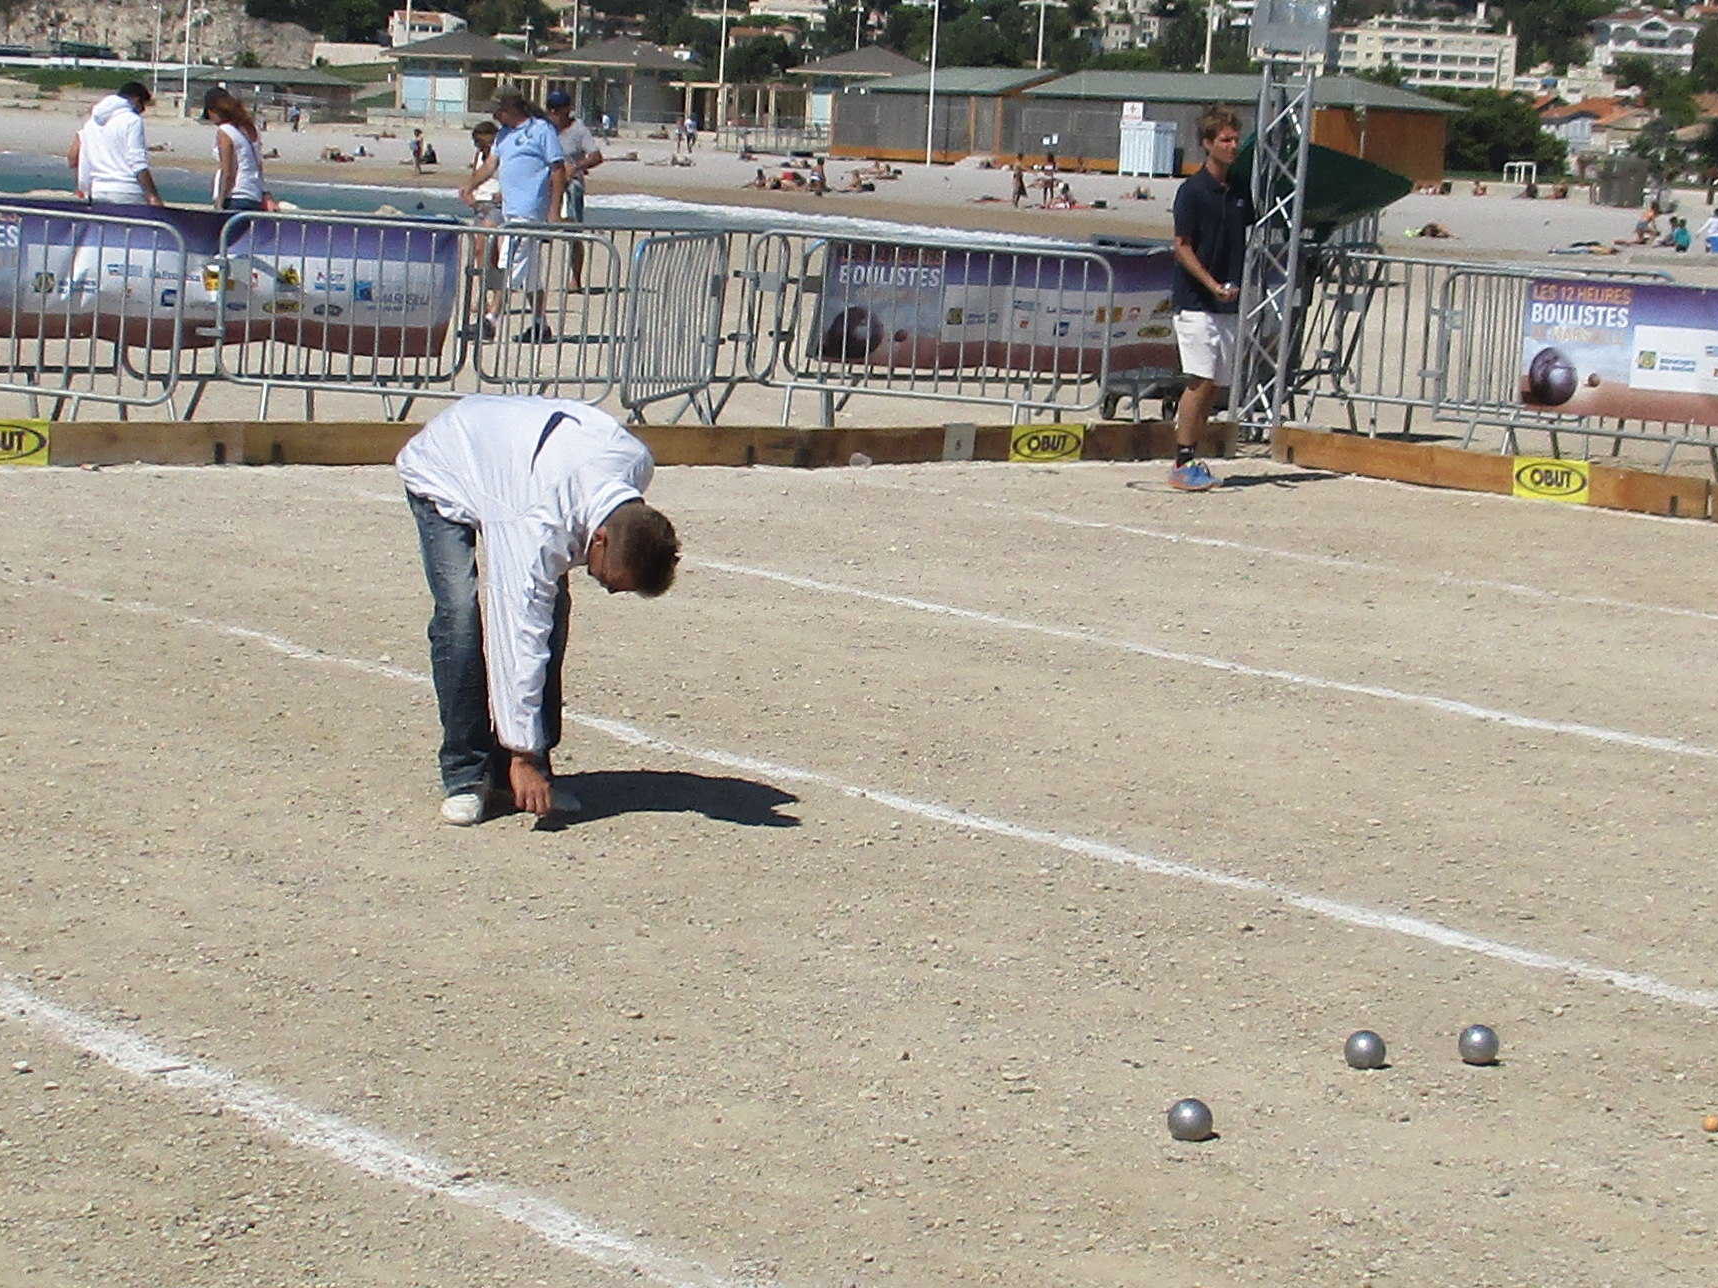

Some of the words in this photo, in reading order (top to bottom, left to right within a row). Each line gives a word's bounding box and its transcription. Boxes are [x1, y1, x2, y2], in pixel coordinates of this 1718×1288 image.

[839, 264, 941, 287] BOULISTES
[1533, 284, 1557, 301] LES
[1560, 285, 1576, 302] 12
[1577, 287, 1632, 305] HEURES
[1531, 302, 1630, 328] BOULISTES
[1028, 434, 1069, 452] OBUT
[1530, 467, 1572, 488] OBUT
